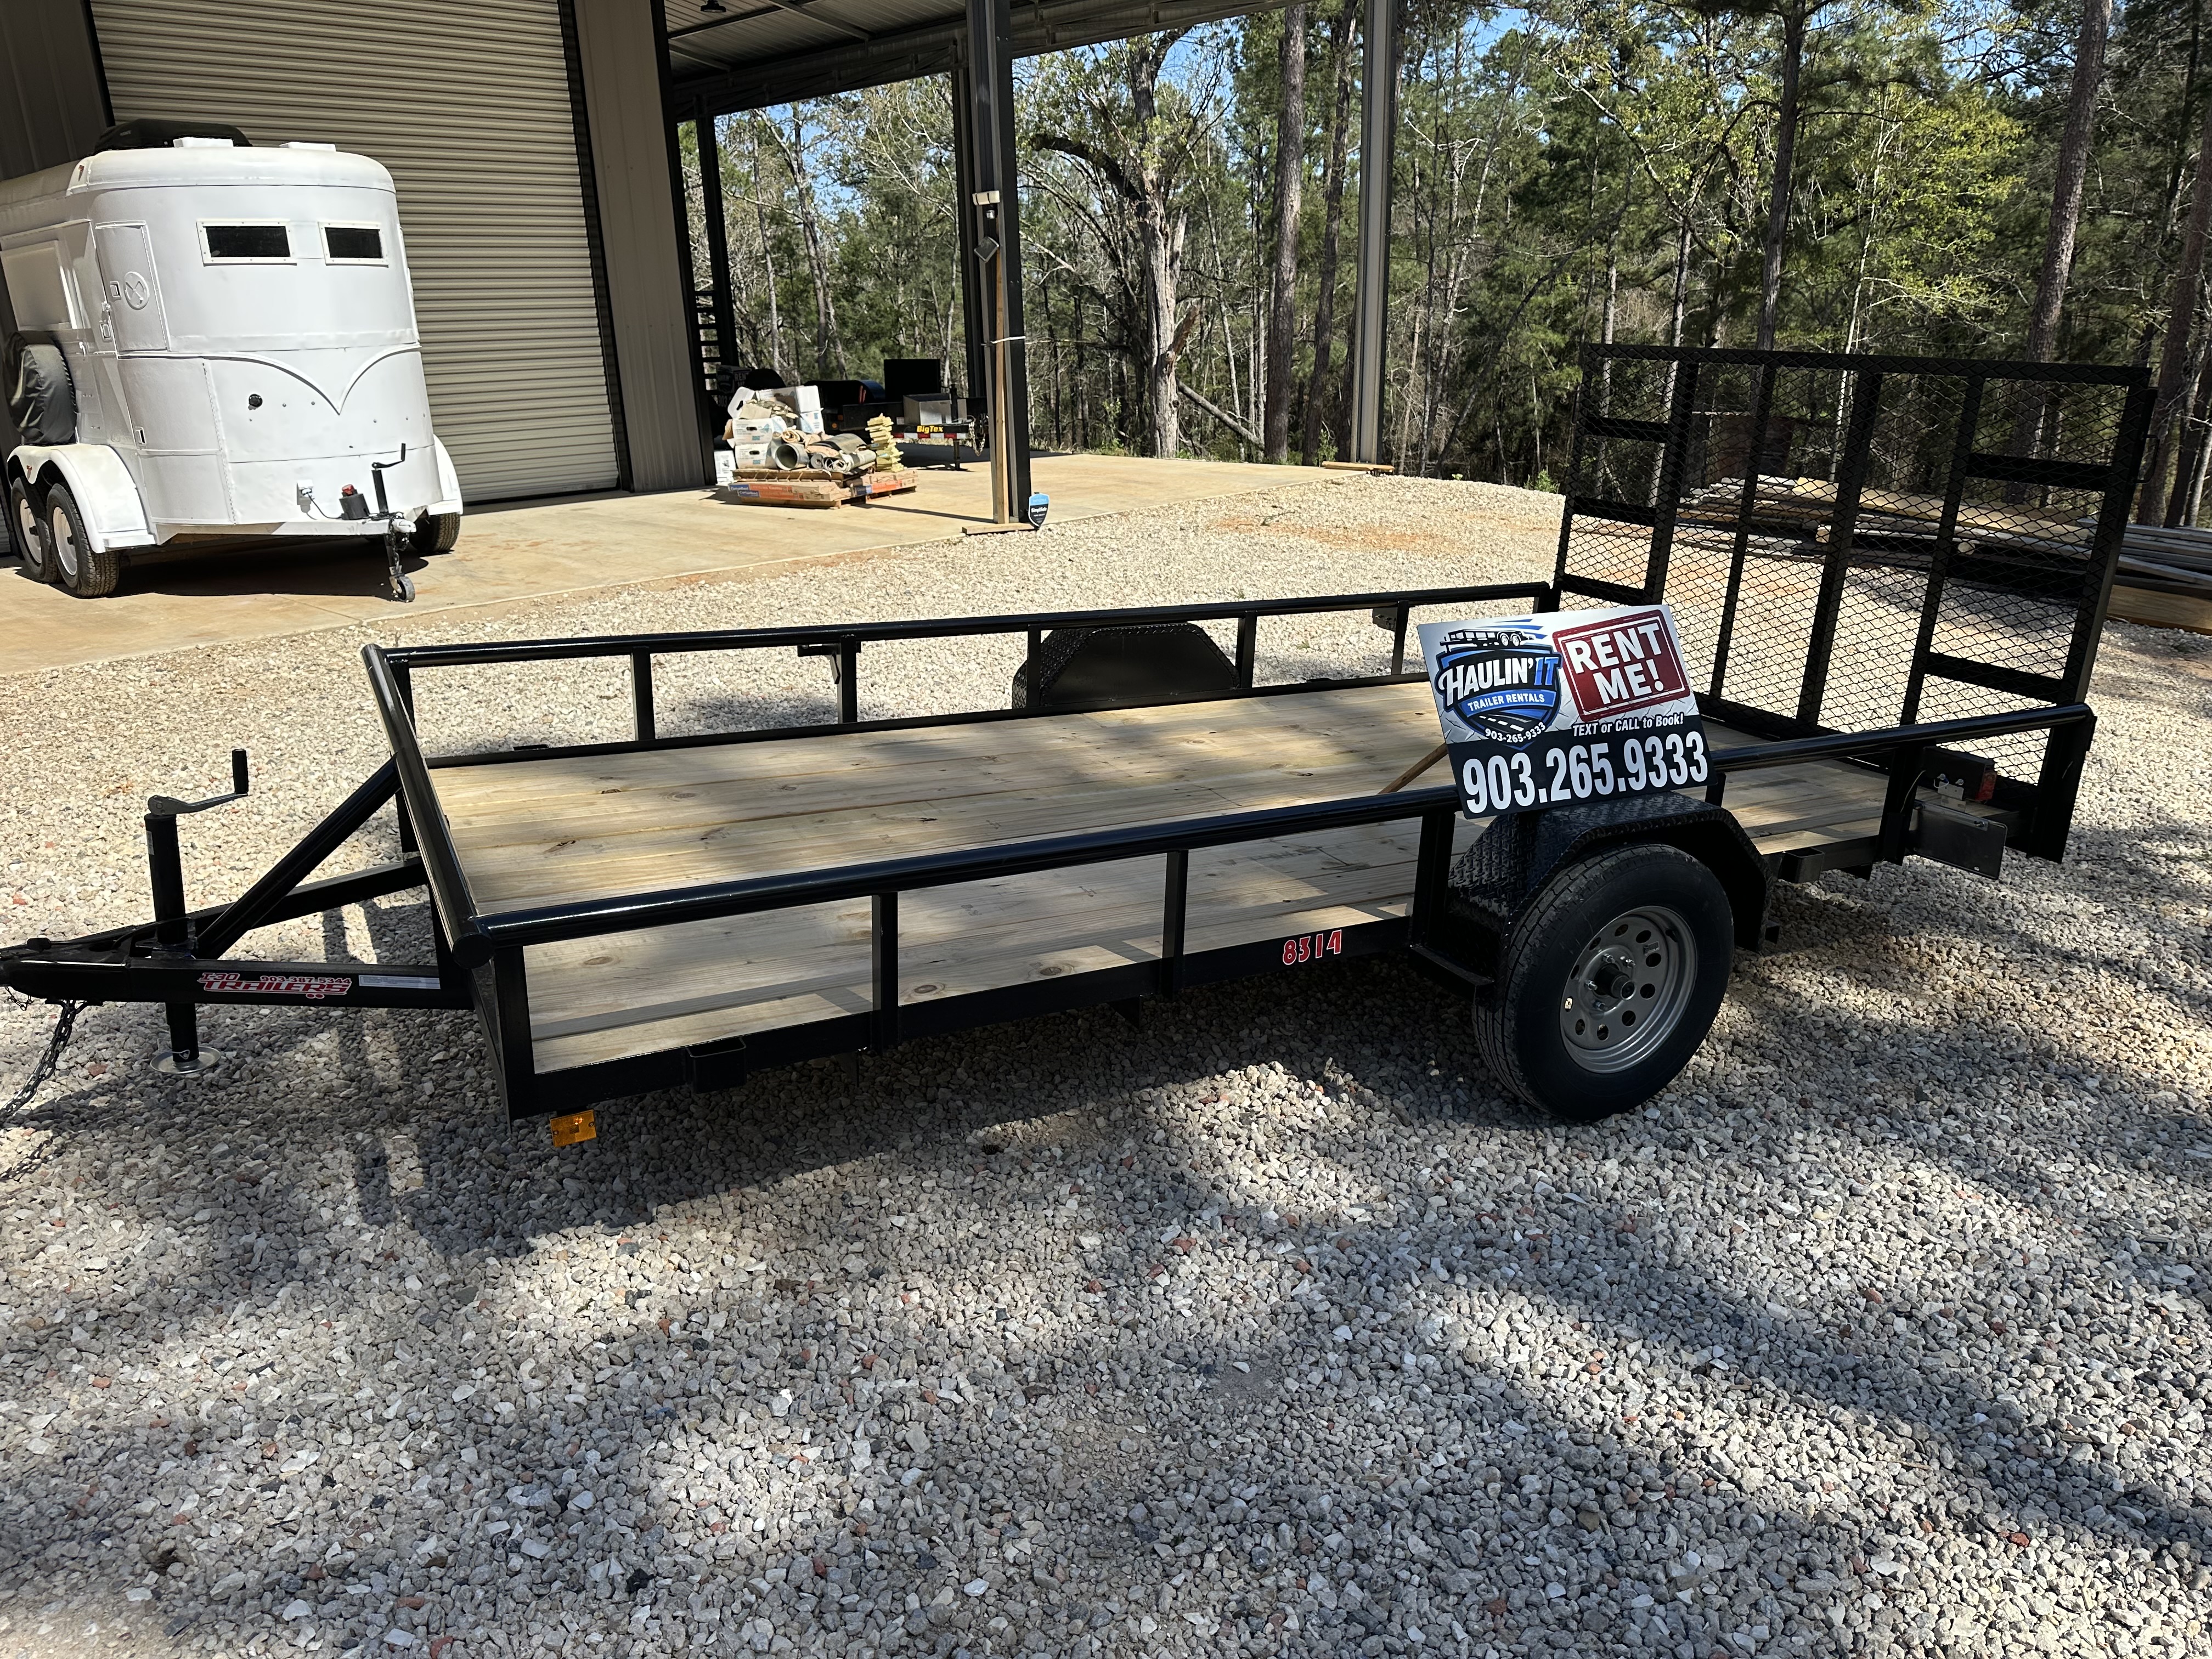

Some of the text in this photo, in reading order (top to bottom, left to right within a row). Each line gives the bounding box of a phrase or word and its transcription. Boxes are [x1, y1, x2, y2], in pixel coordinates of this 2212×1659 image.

[917, 425, 944, 434] BigTex
[1565, 623, 1662, 674] RENT
[1593, 659, 1664, 705] ME!
[1467, 692, 1545, 712] TRAILER RENTALS
[1485, 721, 1547, 743] 903-265-9333
[1572, 713, 1684, 737] TEXT or CALL to Book!
[1462, 731, 1708, 814] 903.265.9333
[1282, 929, 1342, 966] 8314
[202, 972, 352, 984] I-30 903-387-5344
[204, 980, 352, 994] TRAILERS
